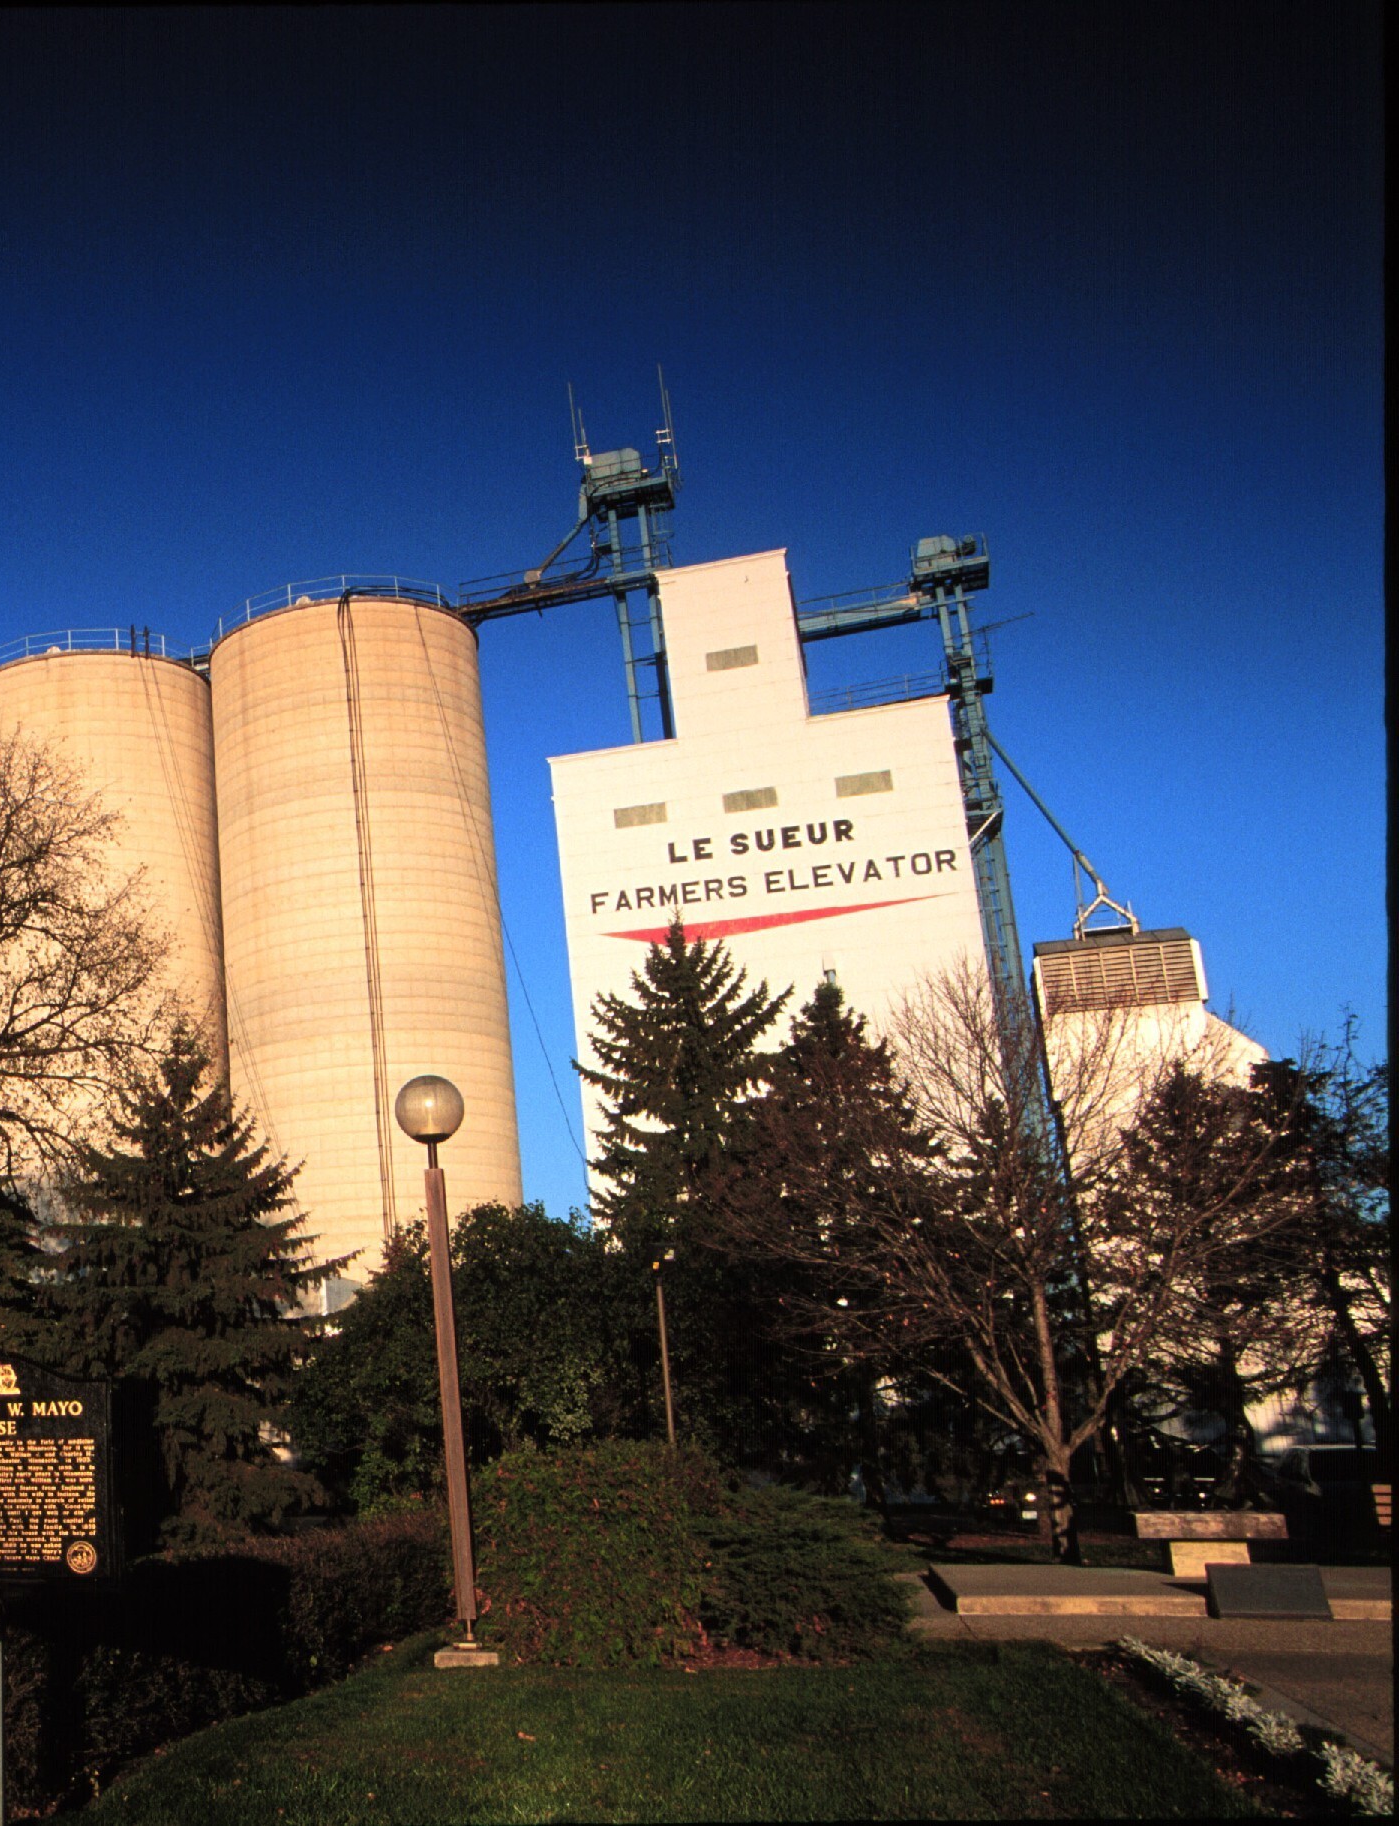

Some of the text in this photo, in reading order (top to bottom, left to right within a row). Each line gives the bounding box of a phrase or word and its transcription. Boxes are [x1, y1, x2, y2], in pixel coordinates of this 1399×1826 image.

[668, 819, 854, 863] LE SUEUR
[590, 849, 957, 914] FARMERS ELEVATOR
[7, 1402, 24, 1417] W.
[32, 1401, 83, 1416] MAYO
